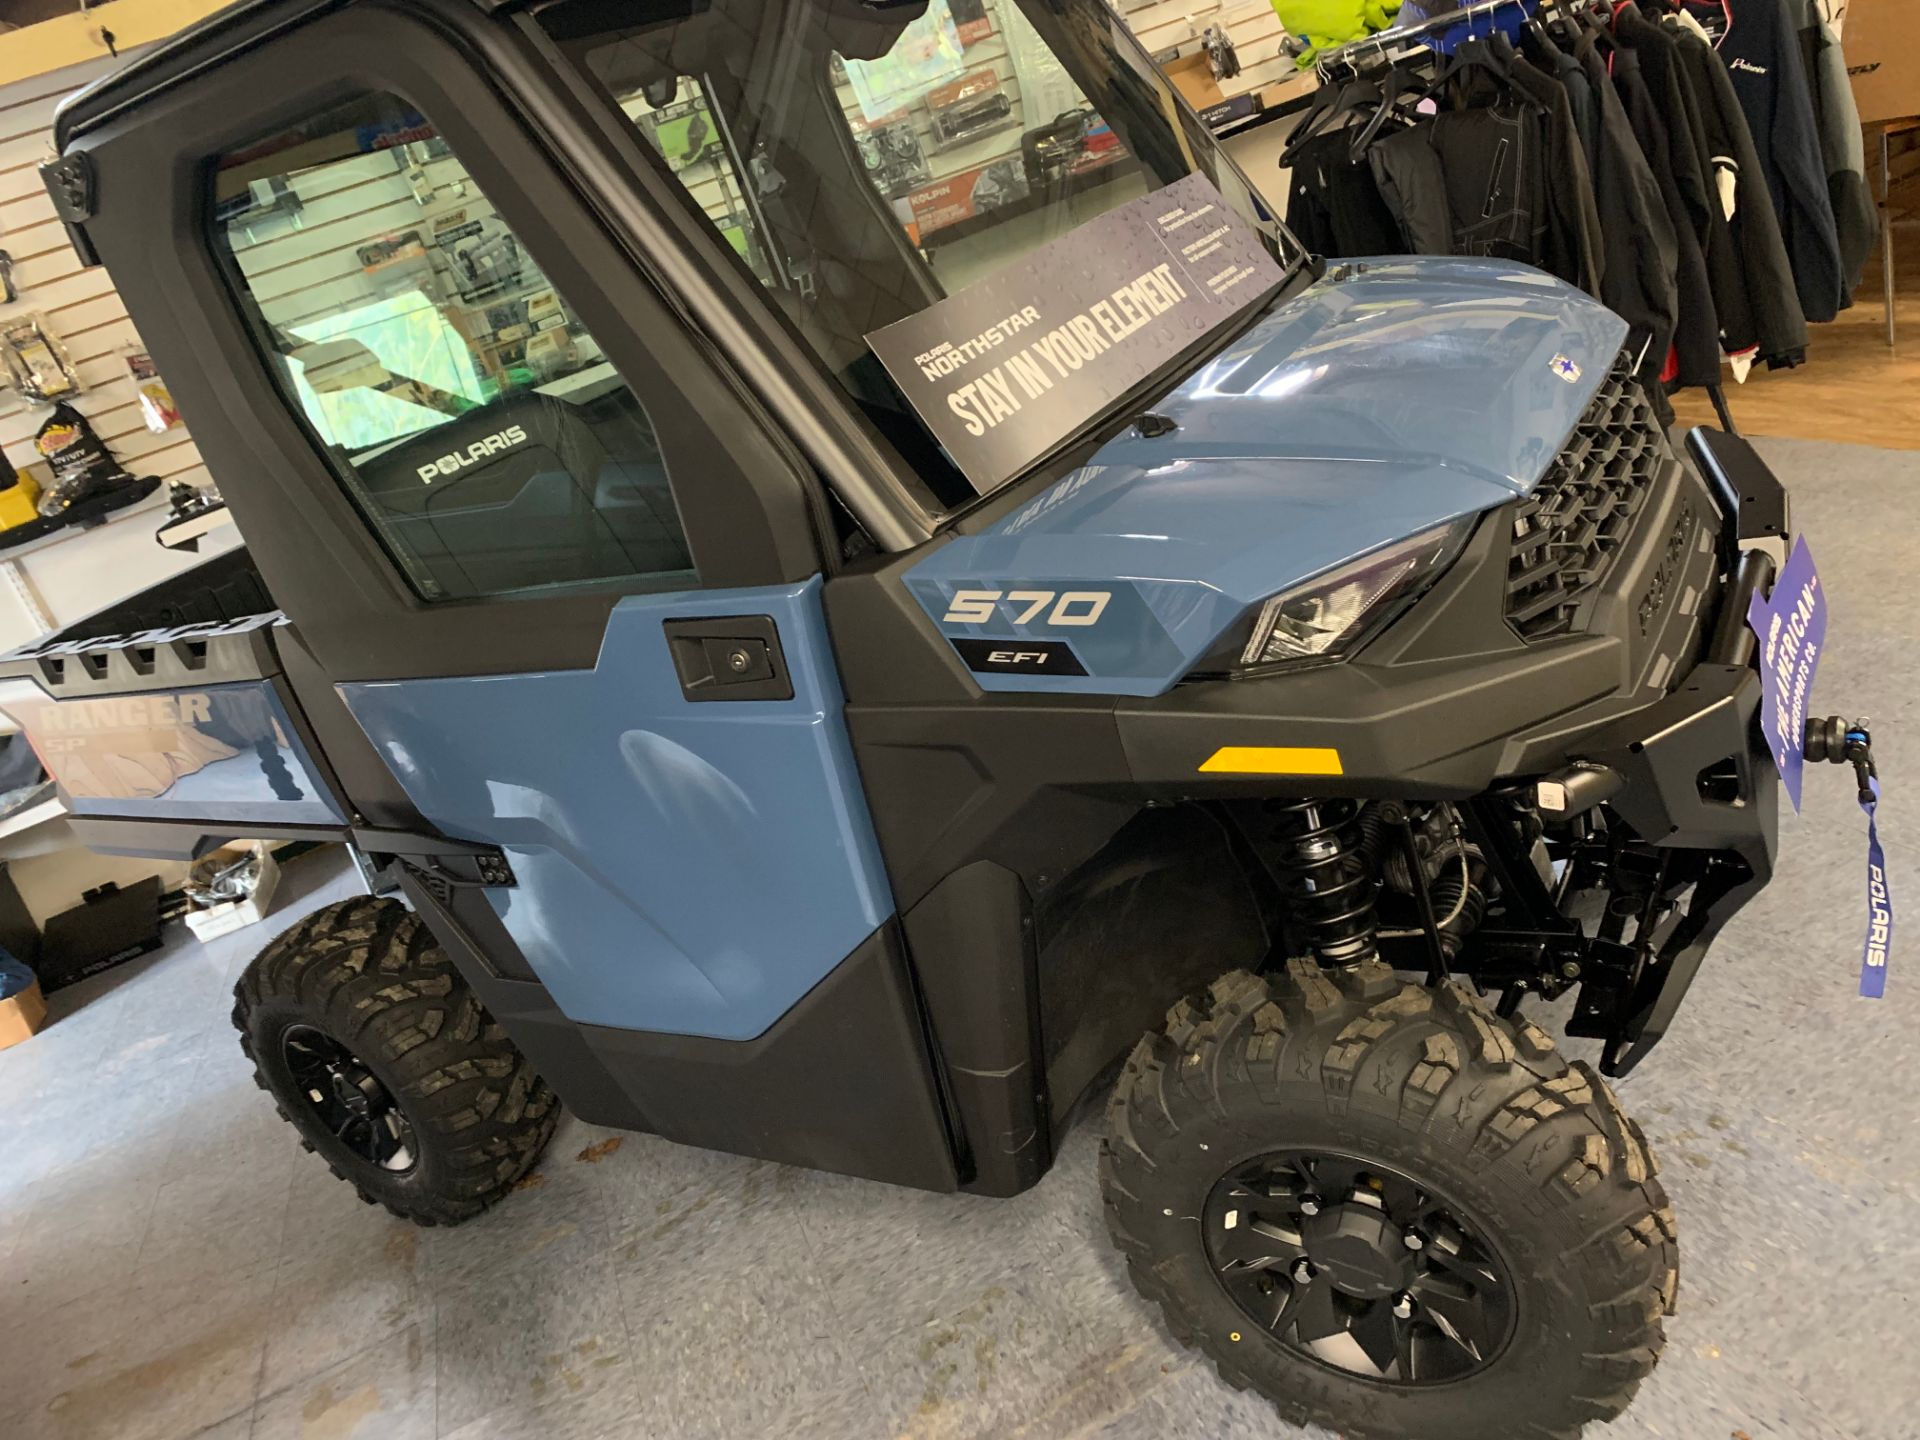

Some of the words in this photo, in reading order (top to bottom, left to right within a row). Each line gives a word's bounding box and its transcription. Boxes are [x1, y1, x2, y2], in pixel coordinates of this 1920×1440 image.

[1730, 58, 1768, 75] Polaris
[911, 185, 950, 206] KOLPIN
[914, 341, 953, 366] POLARIS
[921, 305, 1042, 382] NORTHSTAR
[947, 366, 1022, 436] STAY
[1004, 349, 1054, 400] IN
[1031, 314, 1111, 378] YOUR
[1089, 263, 1188, 343] ELEMENT
[416, 425, 527, 484] POLARIS
[943, 590, 1112, 626] 570
[987, 651, 1049, 664] EFI
[1776, 583, 1816, 704] AMERICAN
[39, 693, 213, 731] RANGER
[1776, 694, 1790, 751] THE
[43, 737, 87, 753] SP
[1867, 864, 1889, 967] POLARIS
